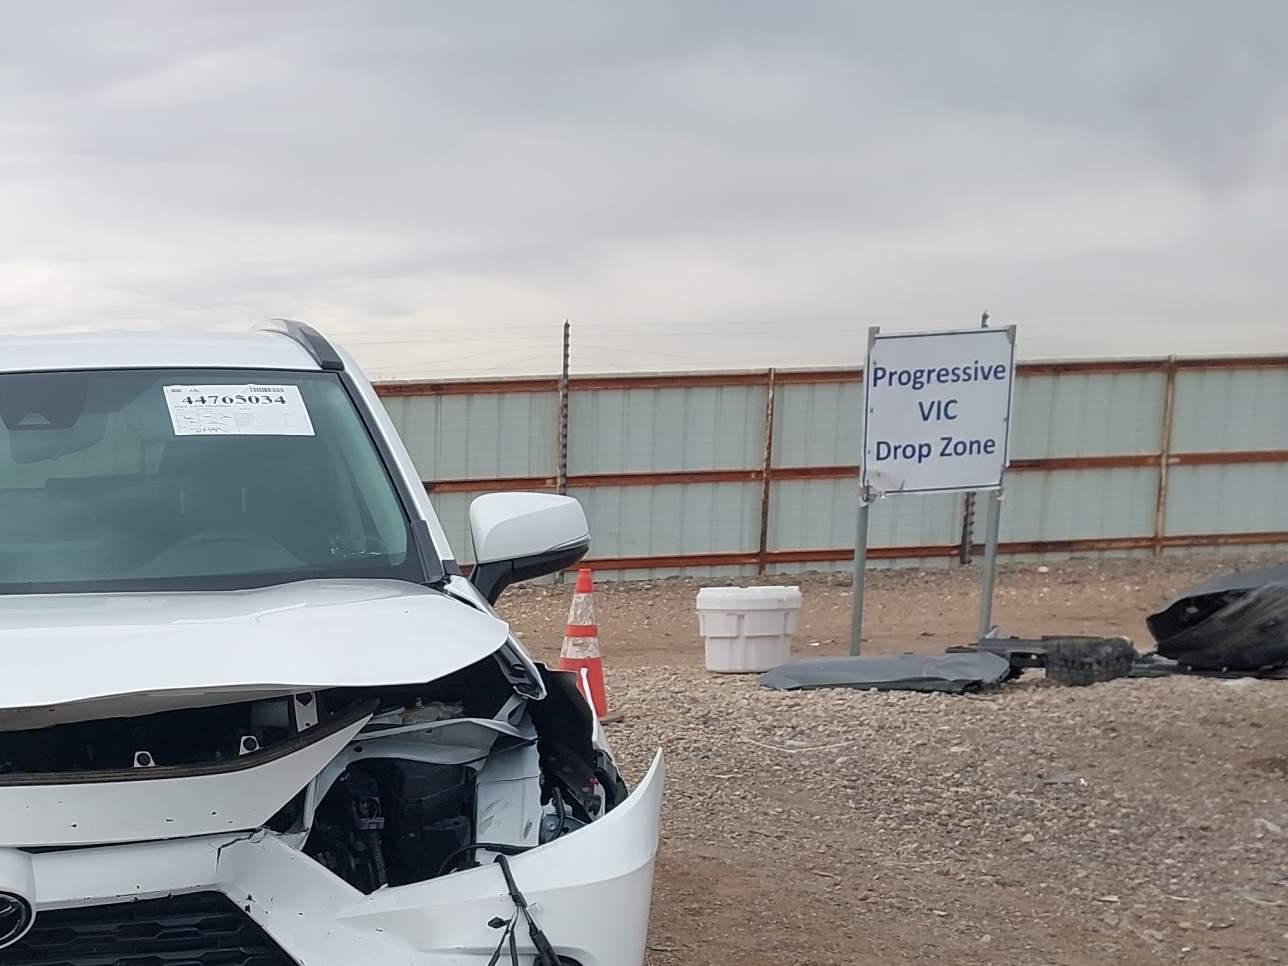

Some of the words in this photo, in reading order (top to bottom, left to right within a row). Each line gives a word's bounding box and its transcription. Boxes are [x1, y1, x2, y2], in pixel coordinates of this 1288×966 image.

[872, 360, 1007, 390] Progressive
[181, 395, 287, 405] 44765034
[918, 399, 959, 422] VIC
[876, 439, 932, 464] Drop
[939, 437, 996, 457] Zone
